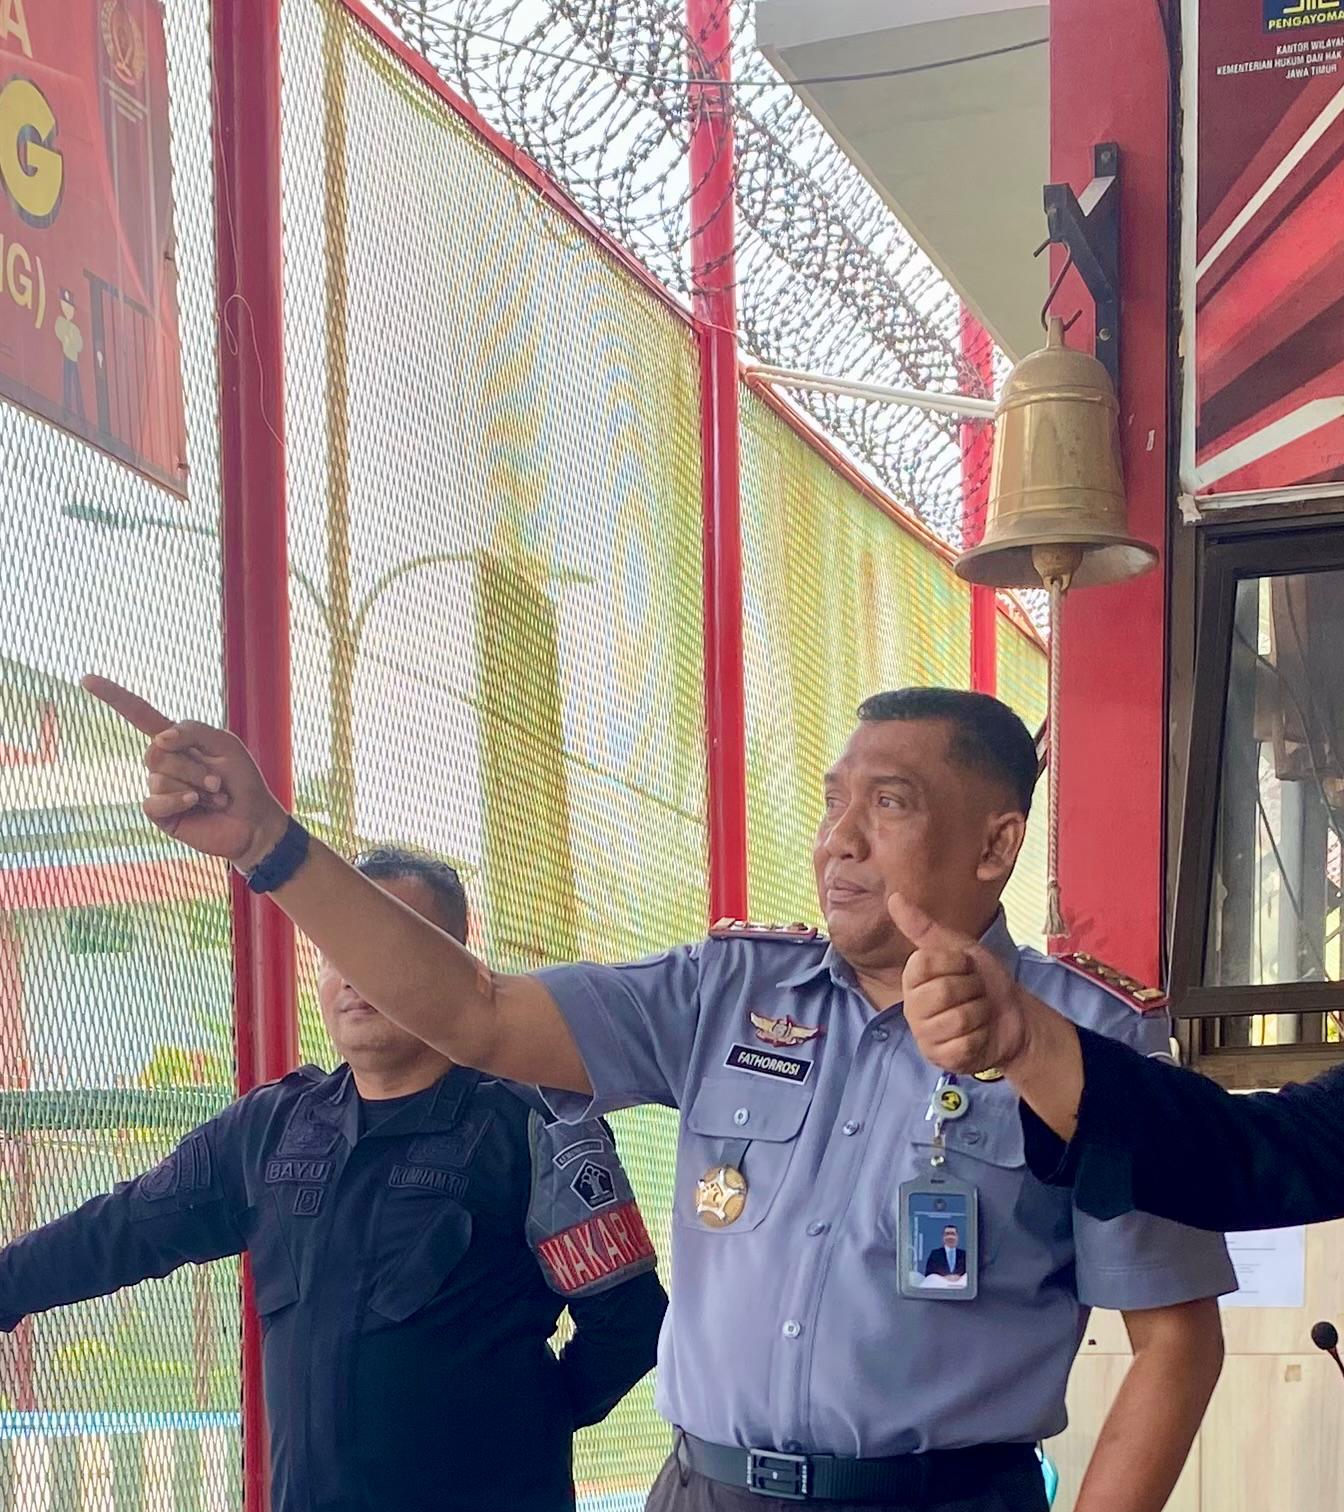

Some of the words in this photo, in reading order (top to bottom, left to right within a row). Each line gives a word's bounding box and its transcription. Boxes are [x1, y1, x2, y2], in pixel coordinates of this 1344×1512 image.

[1276, 43, 1310, 55] KANTOR
[1216, 60, 1273, 75] KEMENTERIAN
[1274, 55, 1304, 68] HUKUM
[1306, 53, 1324, 64] DAN
[1325, 51, 1342, 62] HAK
[1285, 67, 1309, 79] JAWA
[1311, 63, 1337, 75] TIMUR
[737, 1051, 801, 1076] FATHORROSI
[269, 1162, 325, 1179] BAYU
